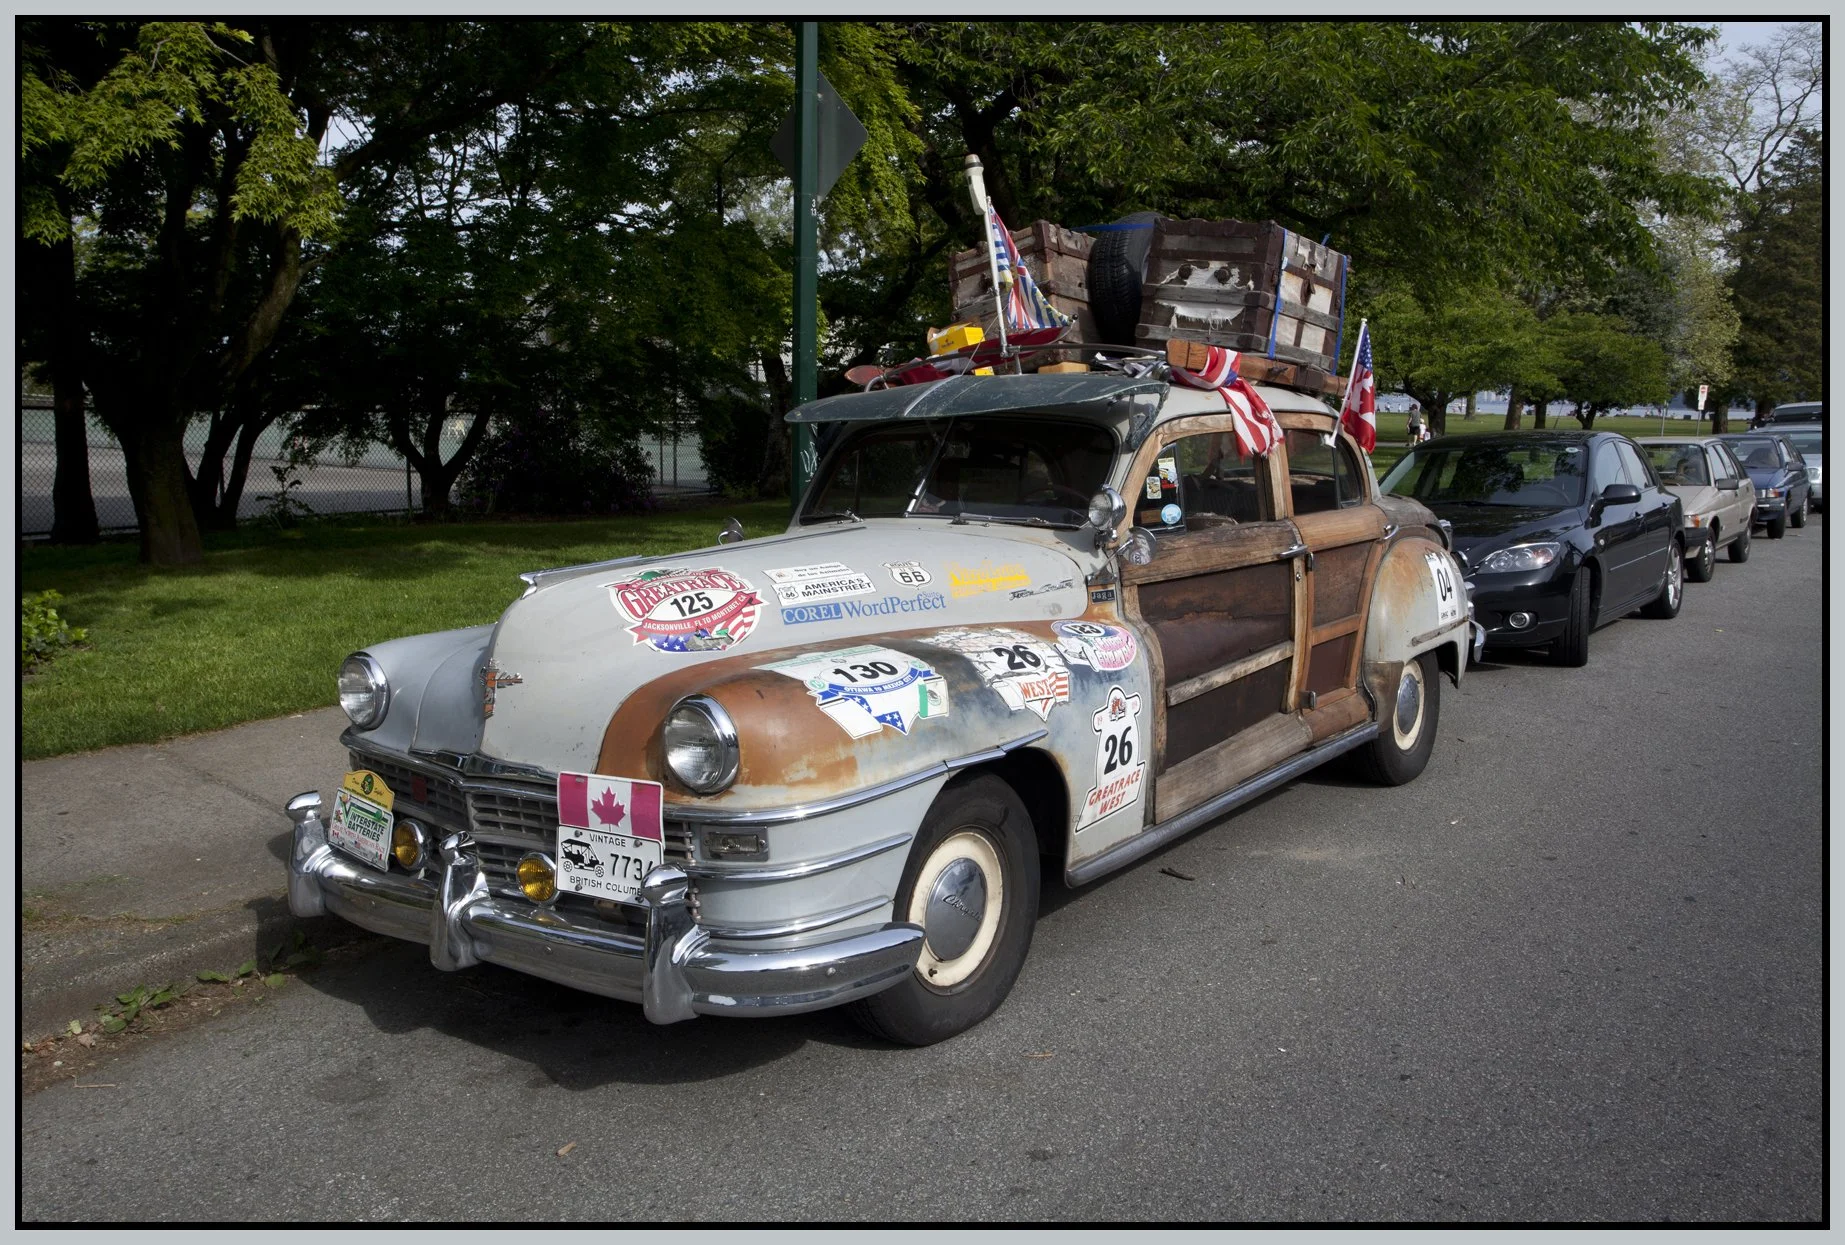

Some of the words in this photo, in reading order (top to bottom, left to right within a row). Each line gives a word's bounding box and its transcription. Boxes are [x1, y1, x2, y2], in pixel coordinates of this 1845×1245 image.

[803, 578, 865, 591] AMERICA'S
[899, 571, 926, 583] 66
[1437, 567, 1453, 602] 04
[619, 573, 746, 620] GREATRACE
[801, 583, 873, 598] MAINSTREET
[670, 591, 714, 618] 125
[703, 617, 711, 625] TO
[738, 595, 747, 603] CA
[782, 603, 842, 624] COREL
[842, 593, 947, 619] WordPerfect
[993, 644, 1041, 671] 26
[832, 661, 899, 683] 130
[882, 681, 904, 690] MEXICO
[1018, 679, 1052, 698] WEST
[1104, 726, 1133, 775] 26
[1088, 768, 1141, 807] GREATRACE
[1099, 791, 1126, 815] WEST
[347, 821, 381, 842] BATTERIES
[350, 812, 385, 835] INTERSTATE
[589, 833, 626, 847] VINTAGE
[569, 876, 602, 889] BRITISH
[606, 882, 642, 896] COLUMB
